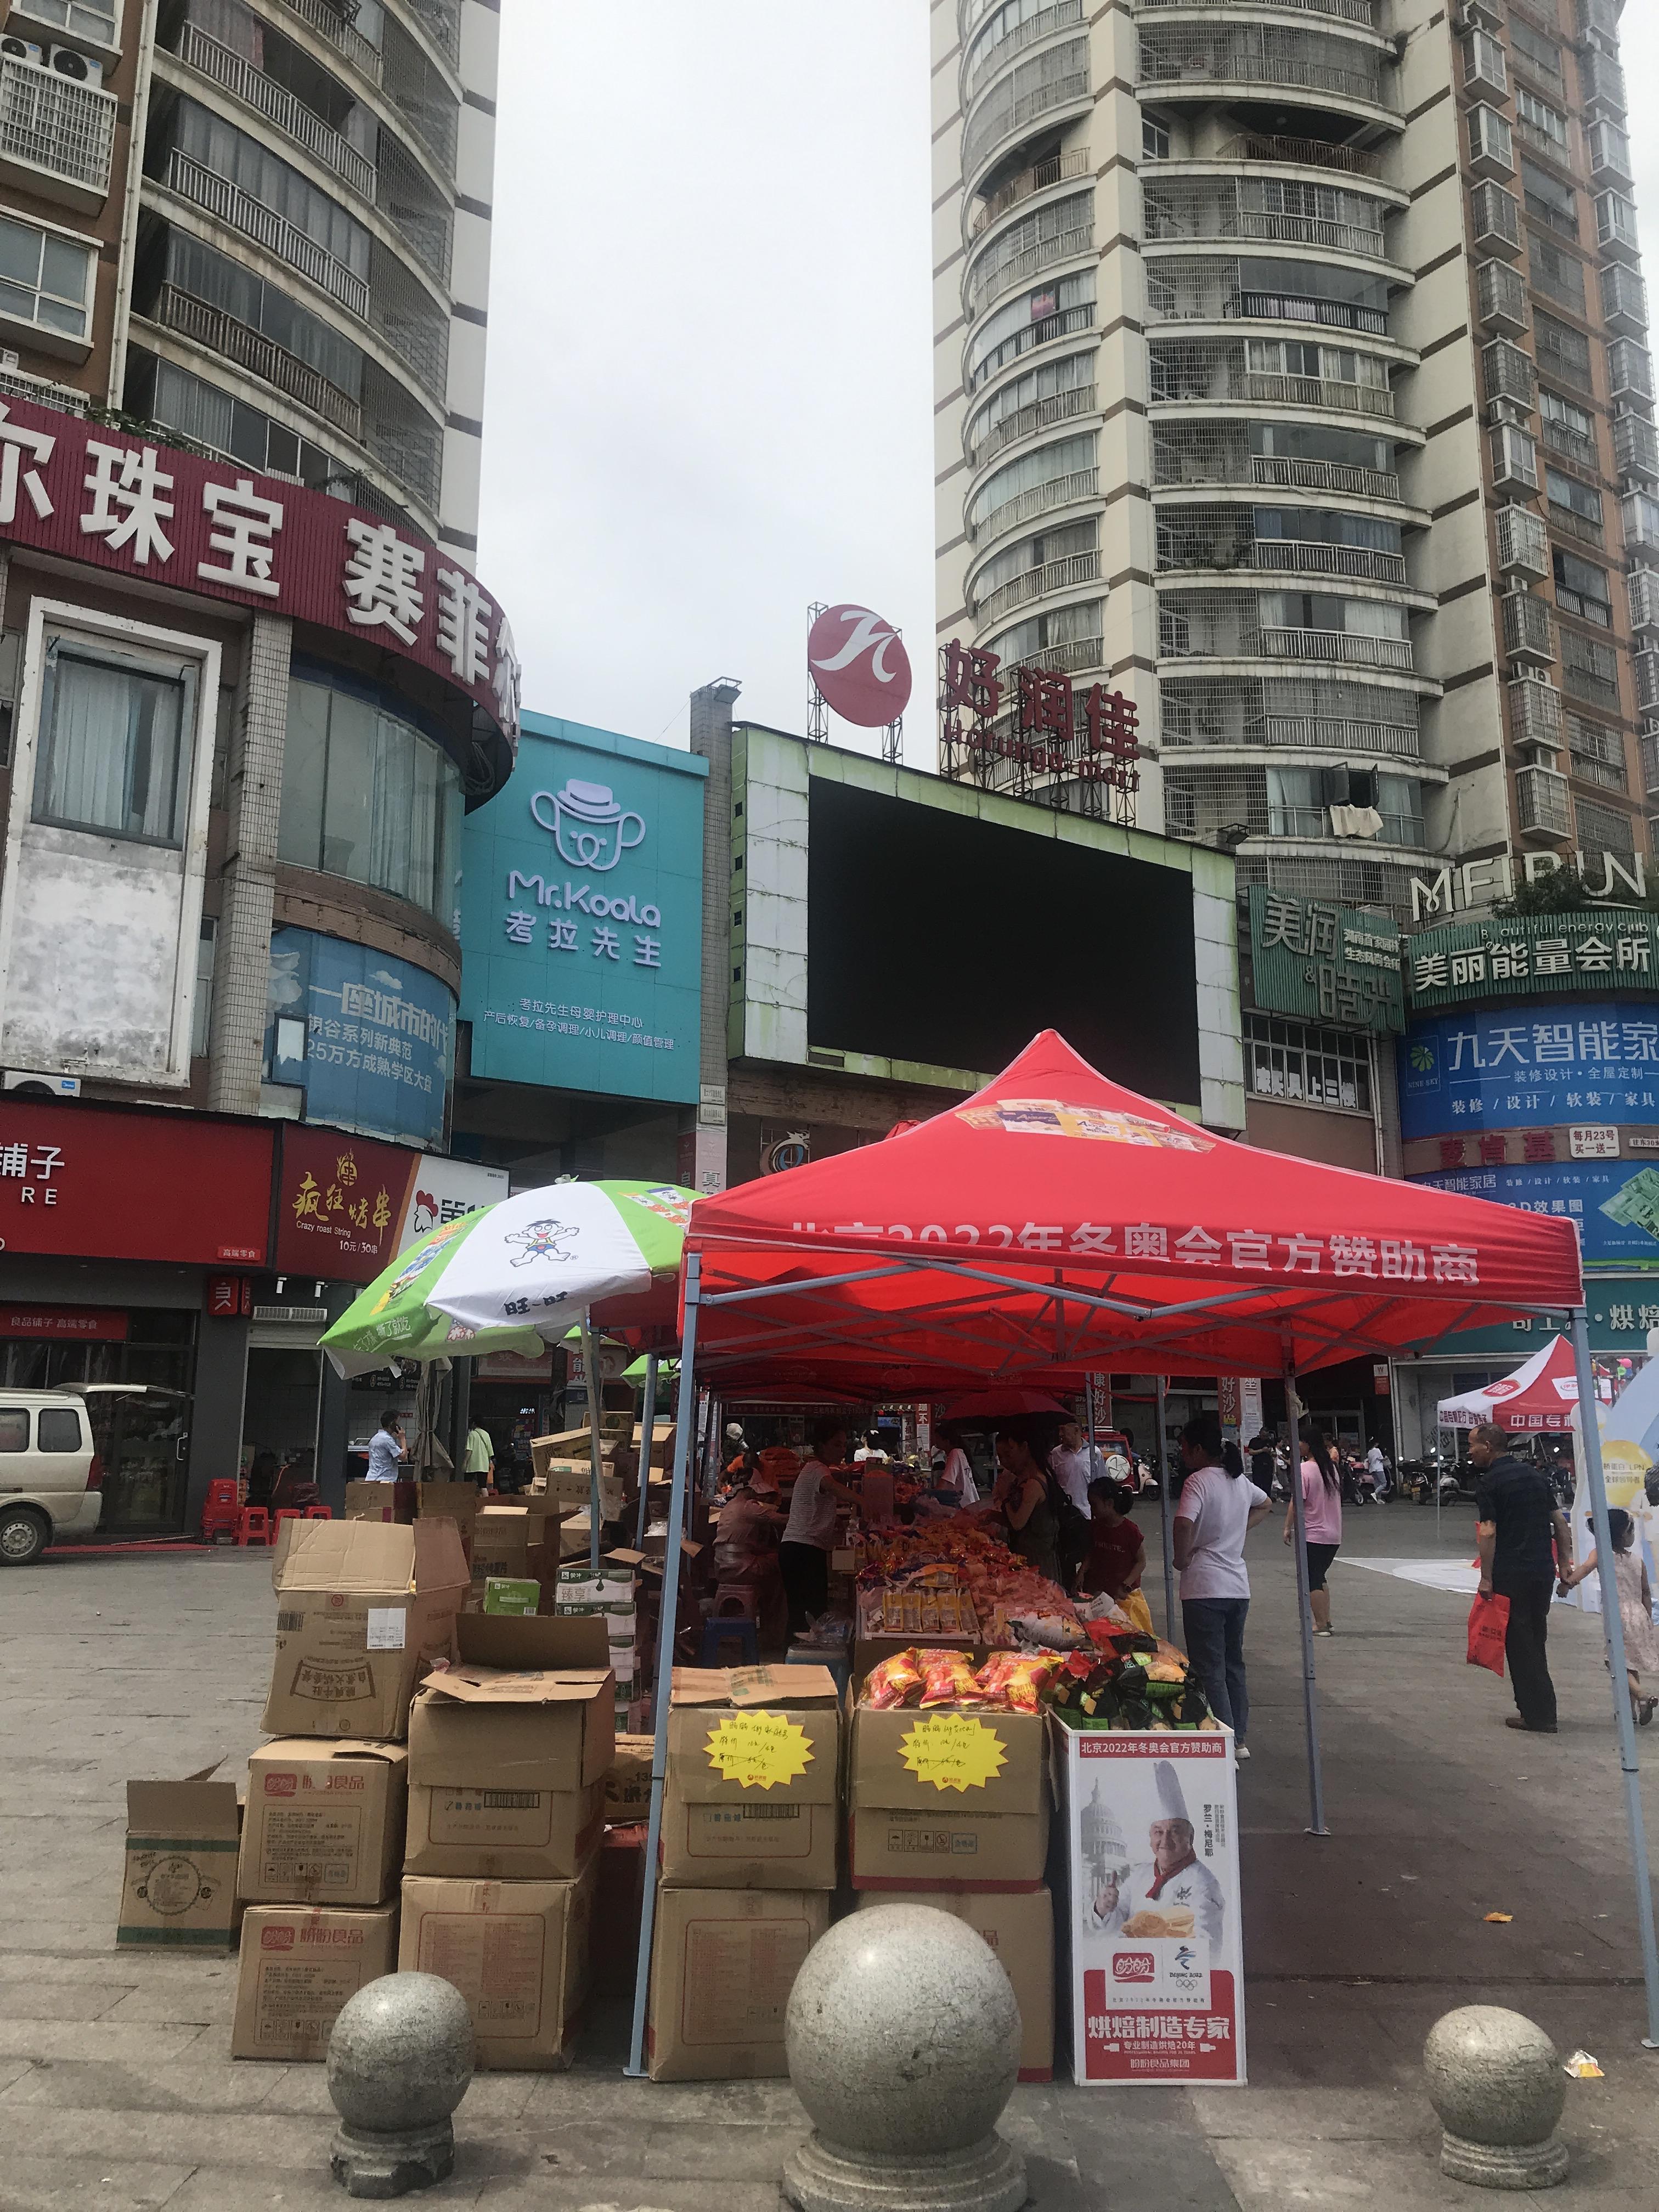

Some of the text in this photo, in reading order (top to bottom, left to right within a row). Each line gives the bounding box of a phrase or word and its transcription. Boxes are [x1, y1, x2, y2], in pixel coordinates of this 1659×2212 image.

[938, 638, 1141, 760] 好润佳
[509, 870, 662, 928] Mr.Koala
[506, 910, 662, 968] 考拉先生
[1414, 936, 1651, 992] 美丽能量会所
[520, 998, 644, 1029] 考拉先生母婴护理中心
[1448, 1020, 1659, 1071] 九天智能家
[1573, 1131, 1615, 1142] 每月23号
[1575, 1143, 1616, 1154] 买一送一
[1422, 1174, 1496, 1193] 天智能家居
[296, 1220, 352, 1238] Crazy roast String
[340, 1239, 379, 1255] 10元/30串
[792, 1221, 1480, 1287] 2年冬奥会官方赞助商
[1081, 1742, 1222, 1754] 北京2022年冬奥会官方赞助商
[1088, 2016, 1230, 2039] 烘焙制造专家
[1123, 2040, 1196, 2051] 专业制造烘焙20年
